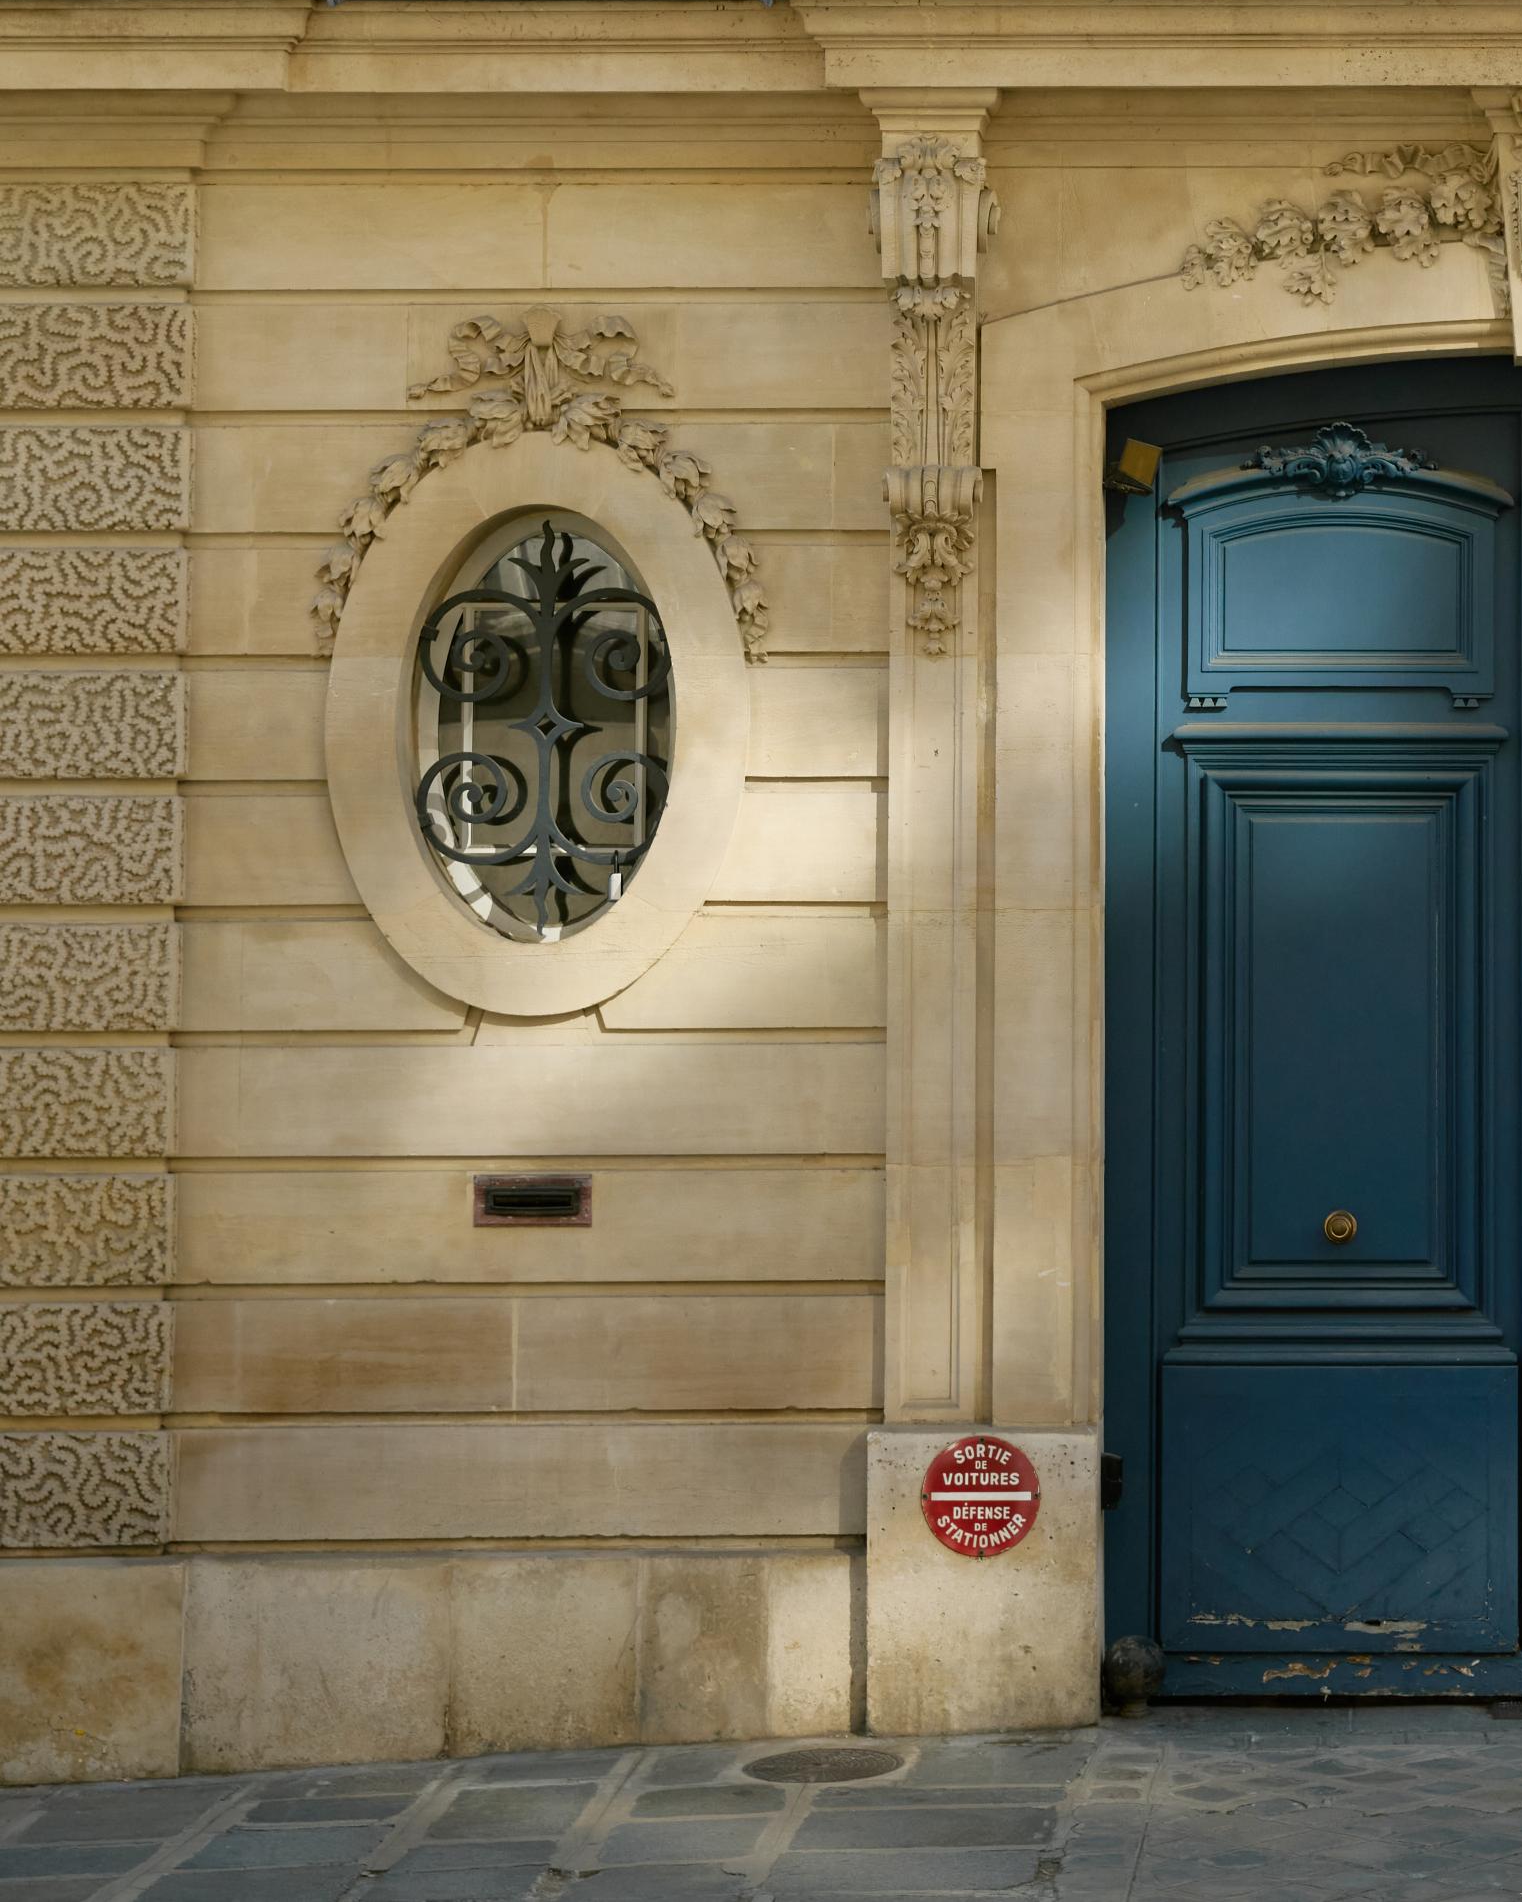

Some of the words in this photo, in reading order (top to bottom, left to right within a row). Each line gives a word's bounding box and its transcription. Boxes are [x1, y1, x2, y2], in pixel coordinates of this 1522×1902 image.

[954, 1444, 1012, 1464] SORTIE
[975, 1460, 987, 1470] DE
[942, 1472, 1020, 1486] VOITURES
[937, 1513, 1026, 1548] STATIONNER
[974, 1522, 987, 1531] DE
